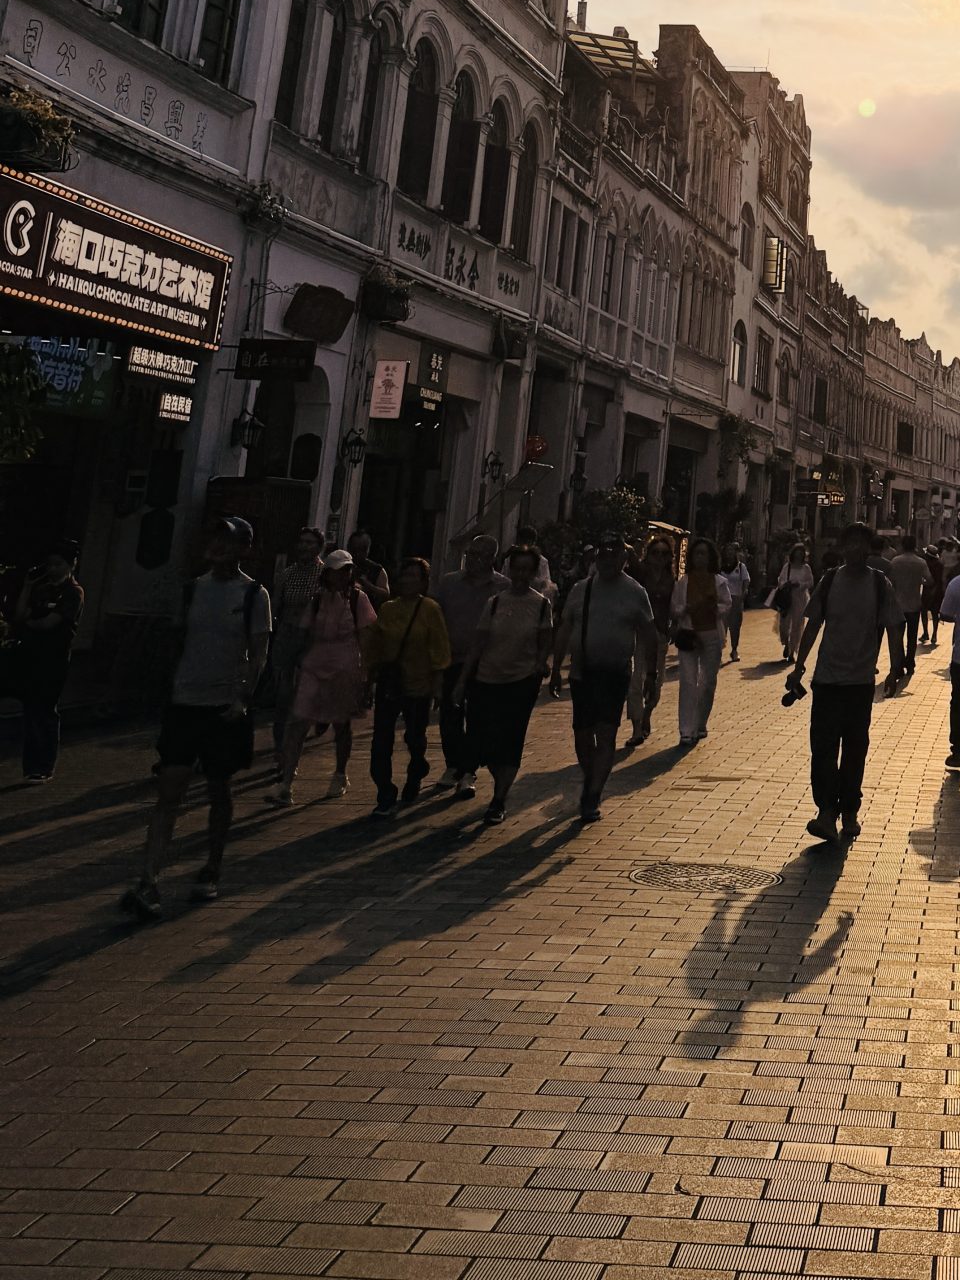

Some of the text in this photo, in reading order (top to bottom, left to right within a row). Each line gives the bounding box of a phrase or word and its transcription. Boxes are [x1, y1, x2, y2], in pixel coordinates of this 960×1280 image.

[16, 265, 33, 280] STAR
[52, 218, 215, 310] 海口巧克力艺术馆
[58, 273, 201, 328] HAIKOU CHOCOLATE ART MUSEUM
